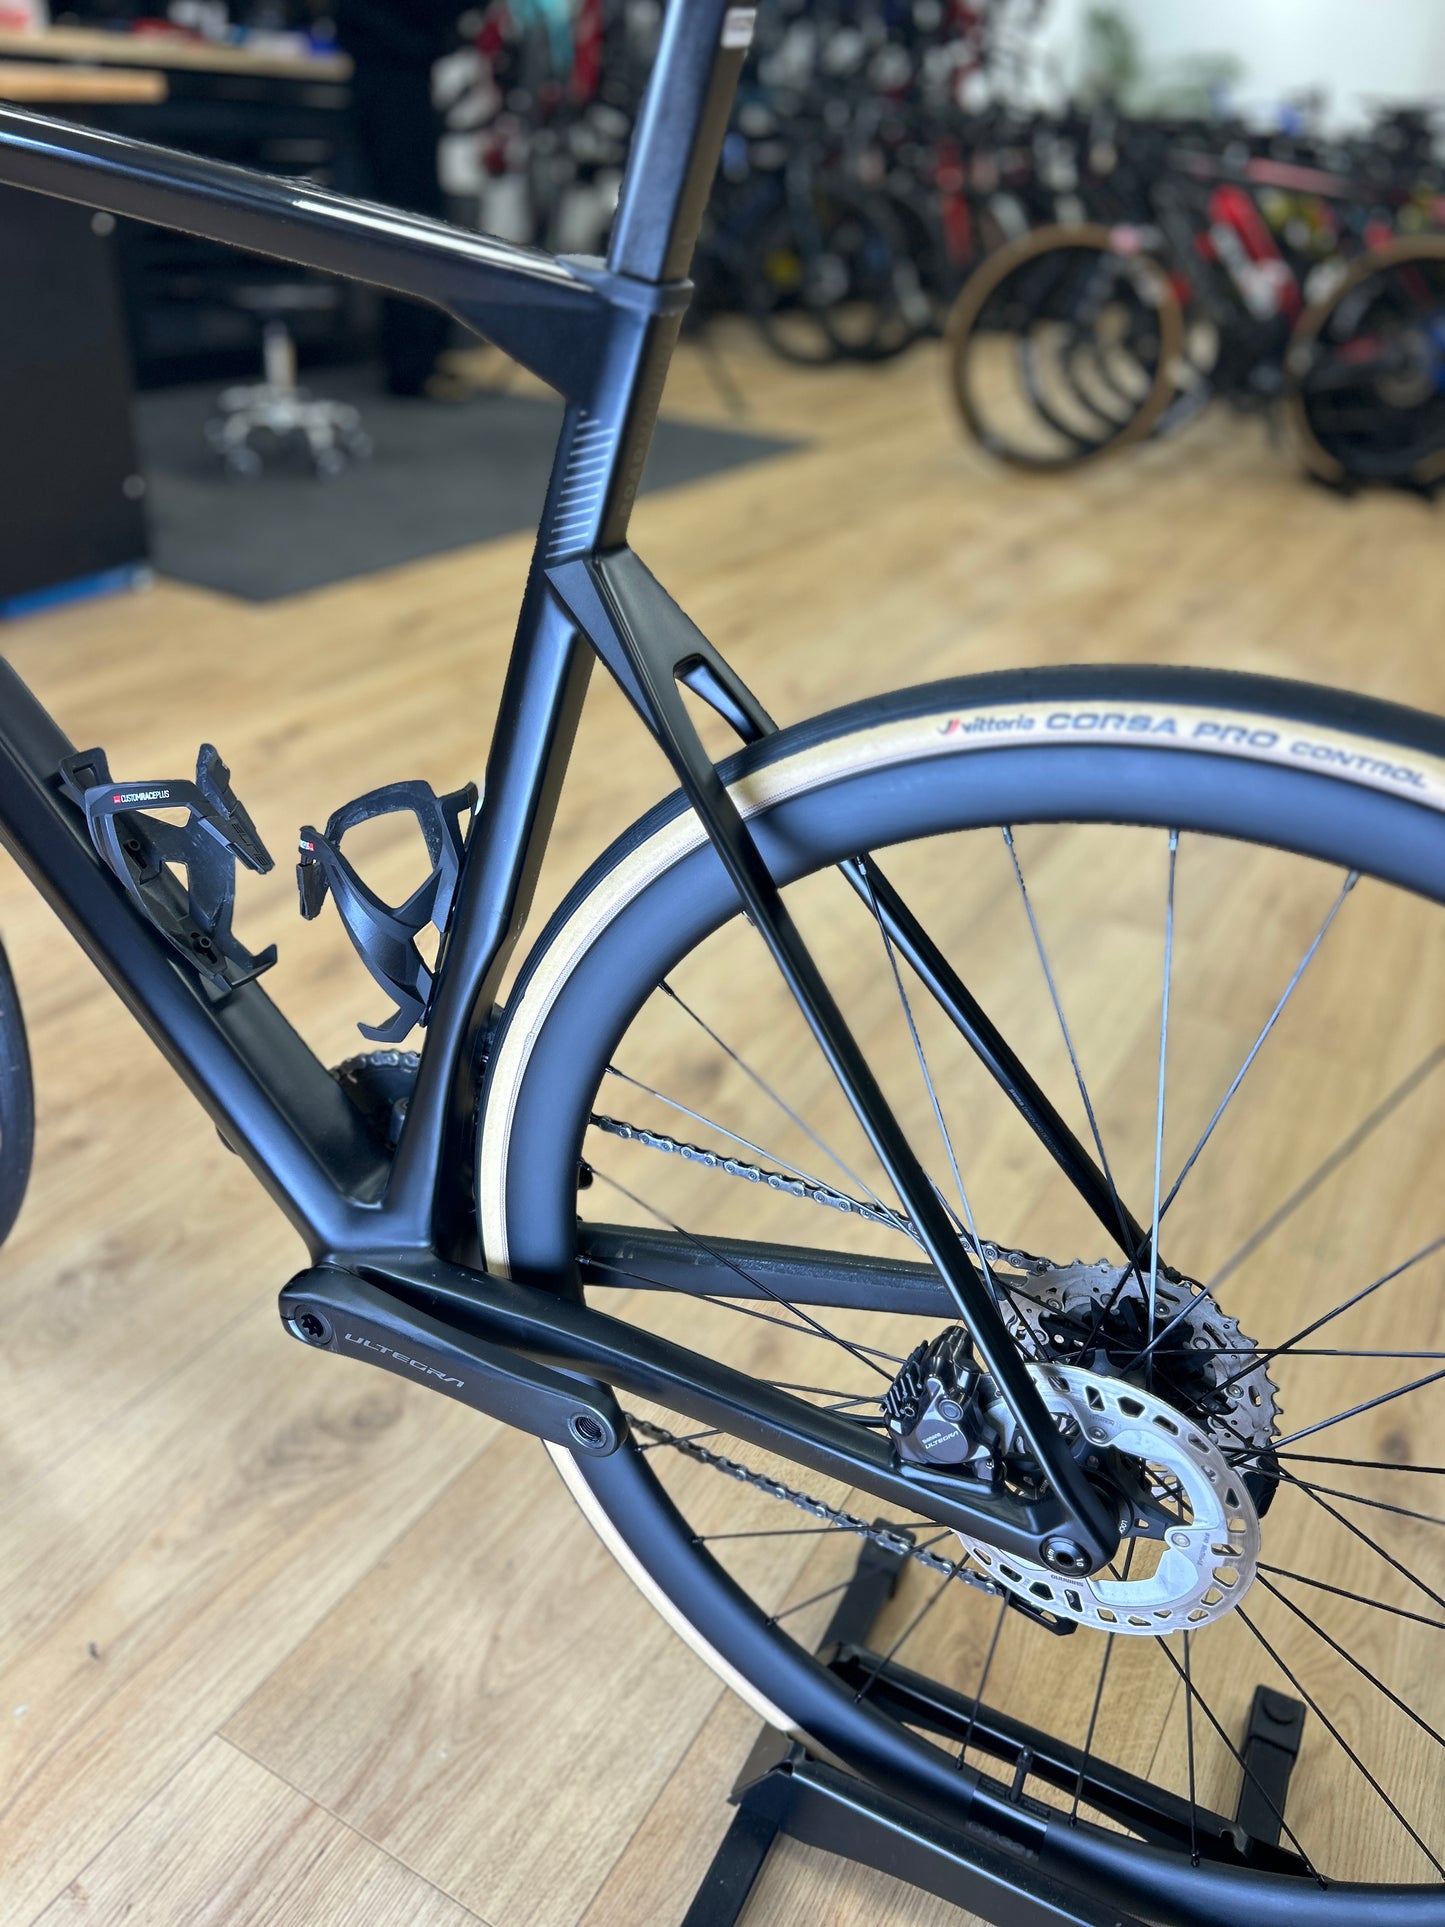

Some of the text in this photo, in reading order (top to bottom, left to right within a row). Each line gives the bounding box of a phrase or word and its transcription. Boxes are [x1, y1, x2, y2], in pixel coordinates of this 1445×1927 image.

[960, 713, 1427, 788] vittoria CORSA PRO CONTROL
[344, 1332, 465, 1388] ULTEGRA
